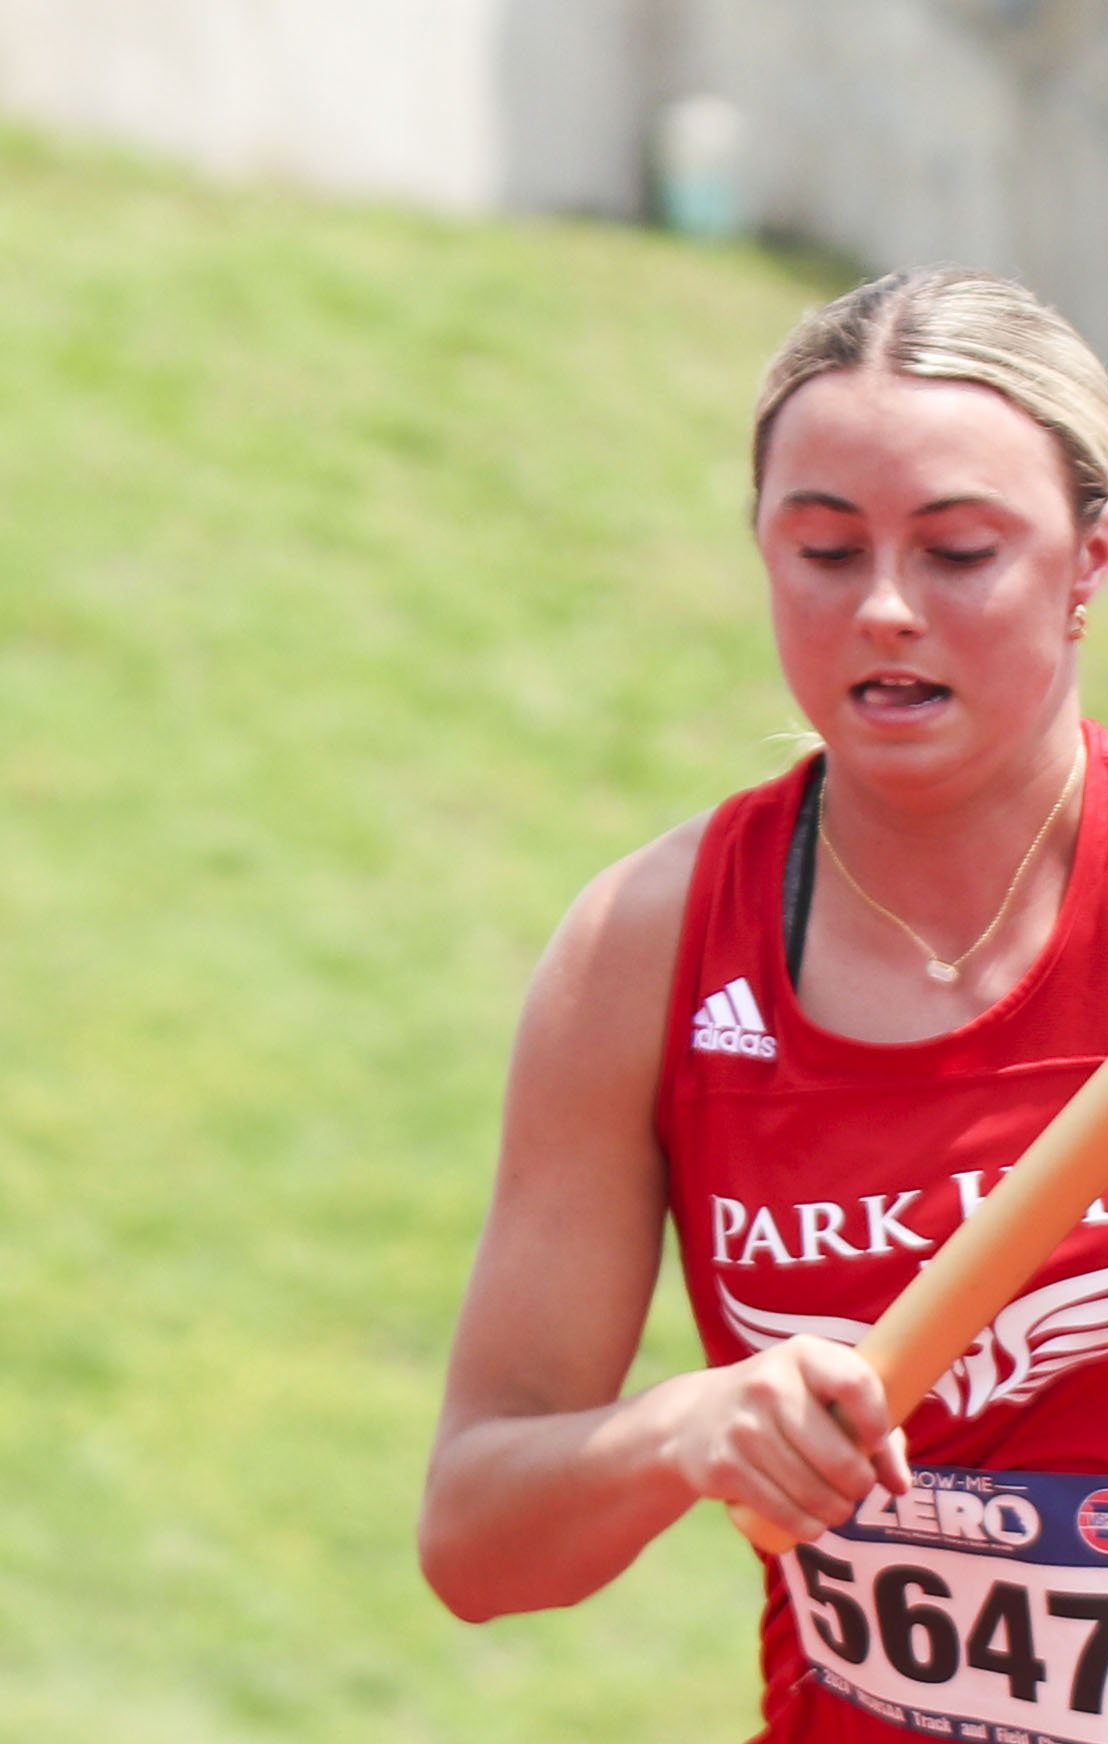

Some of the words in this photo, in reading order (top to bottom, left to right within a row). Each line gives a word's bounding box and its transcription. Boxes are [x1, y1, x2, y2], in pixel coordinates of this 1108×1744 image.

[711, 1189, 933, 1265] PARK
[911, 1470, 994, 1493] HOW-ME
[912, 1710, 952, 1733] Track
